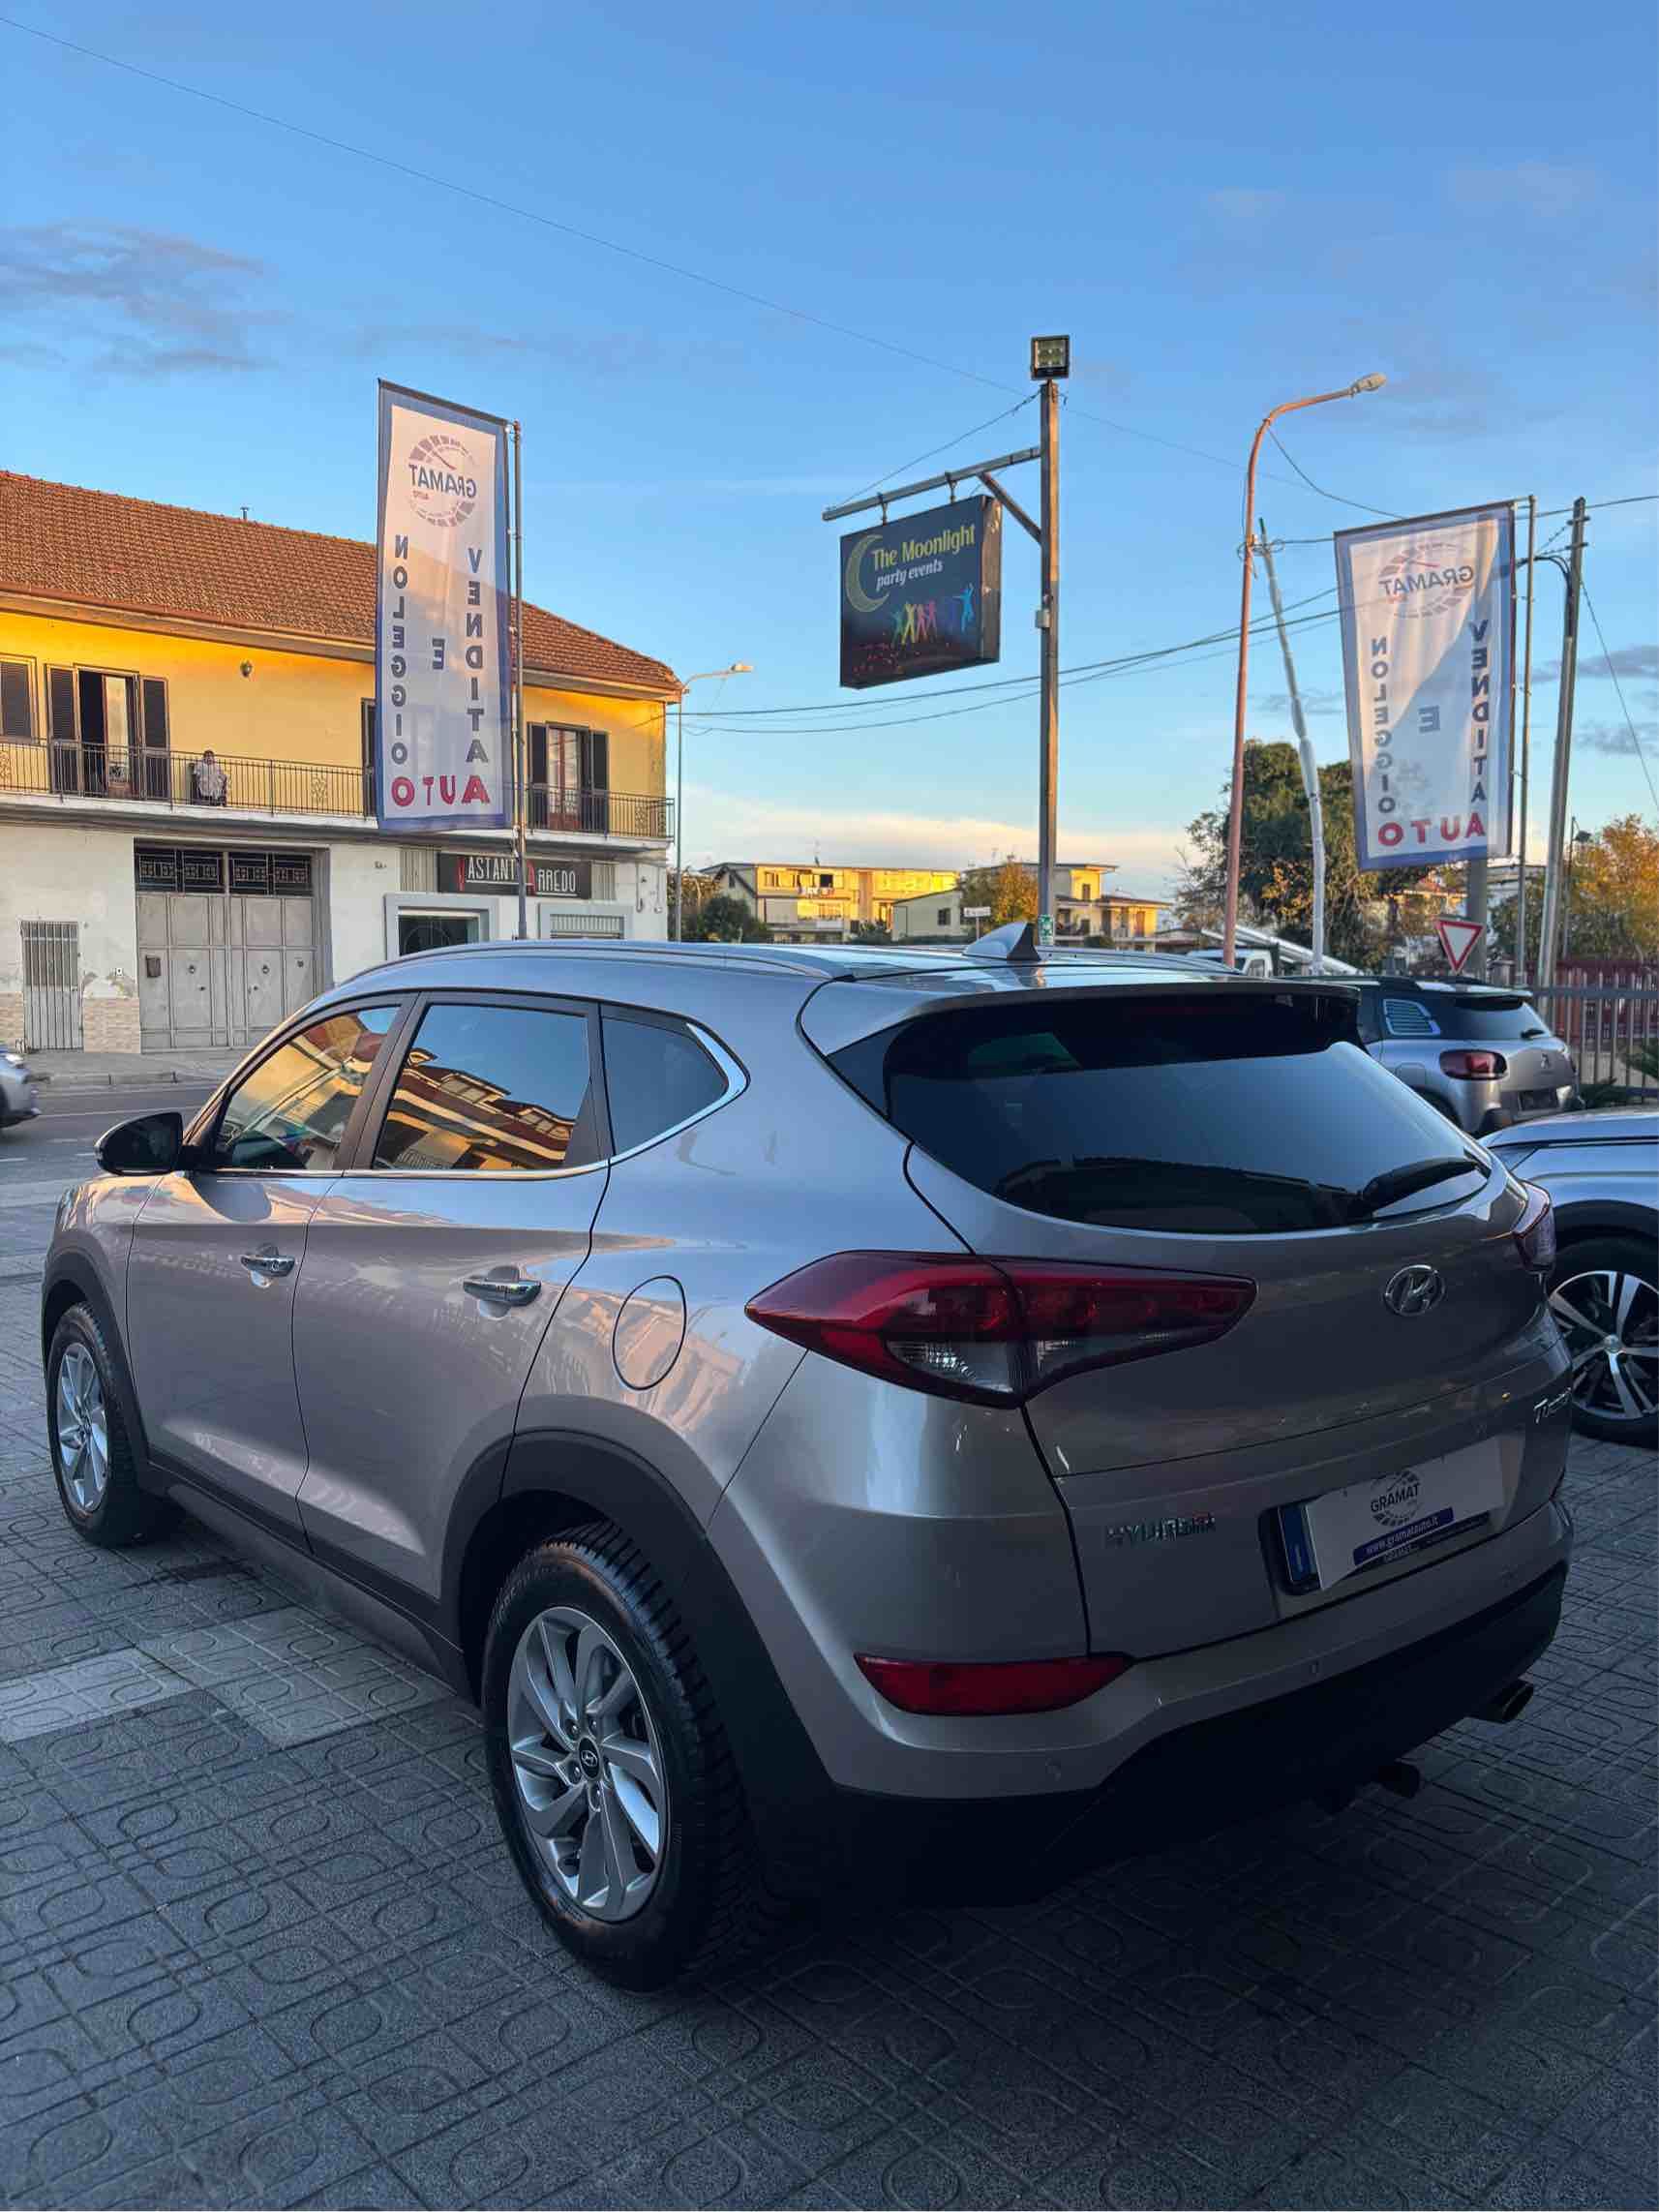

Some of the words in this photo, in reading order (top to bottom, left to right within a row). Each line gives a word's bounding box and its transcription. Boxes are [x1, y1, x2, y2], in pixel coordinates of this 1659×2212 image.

[872, 547, 898, 571] The
[901, 524, 976, 561] Moonlight
[875, 568, 908, 591] party
[908, 559, 944, 579] events
[457, 856, 520, 893] VASTANT
[1371, 1483, 1420, 1512] GRAMAT
